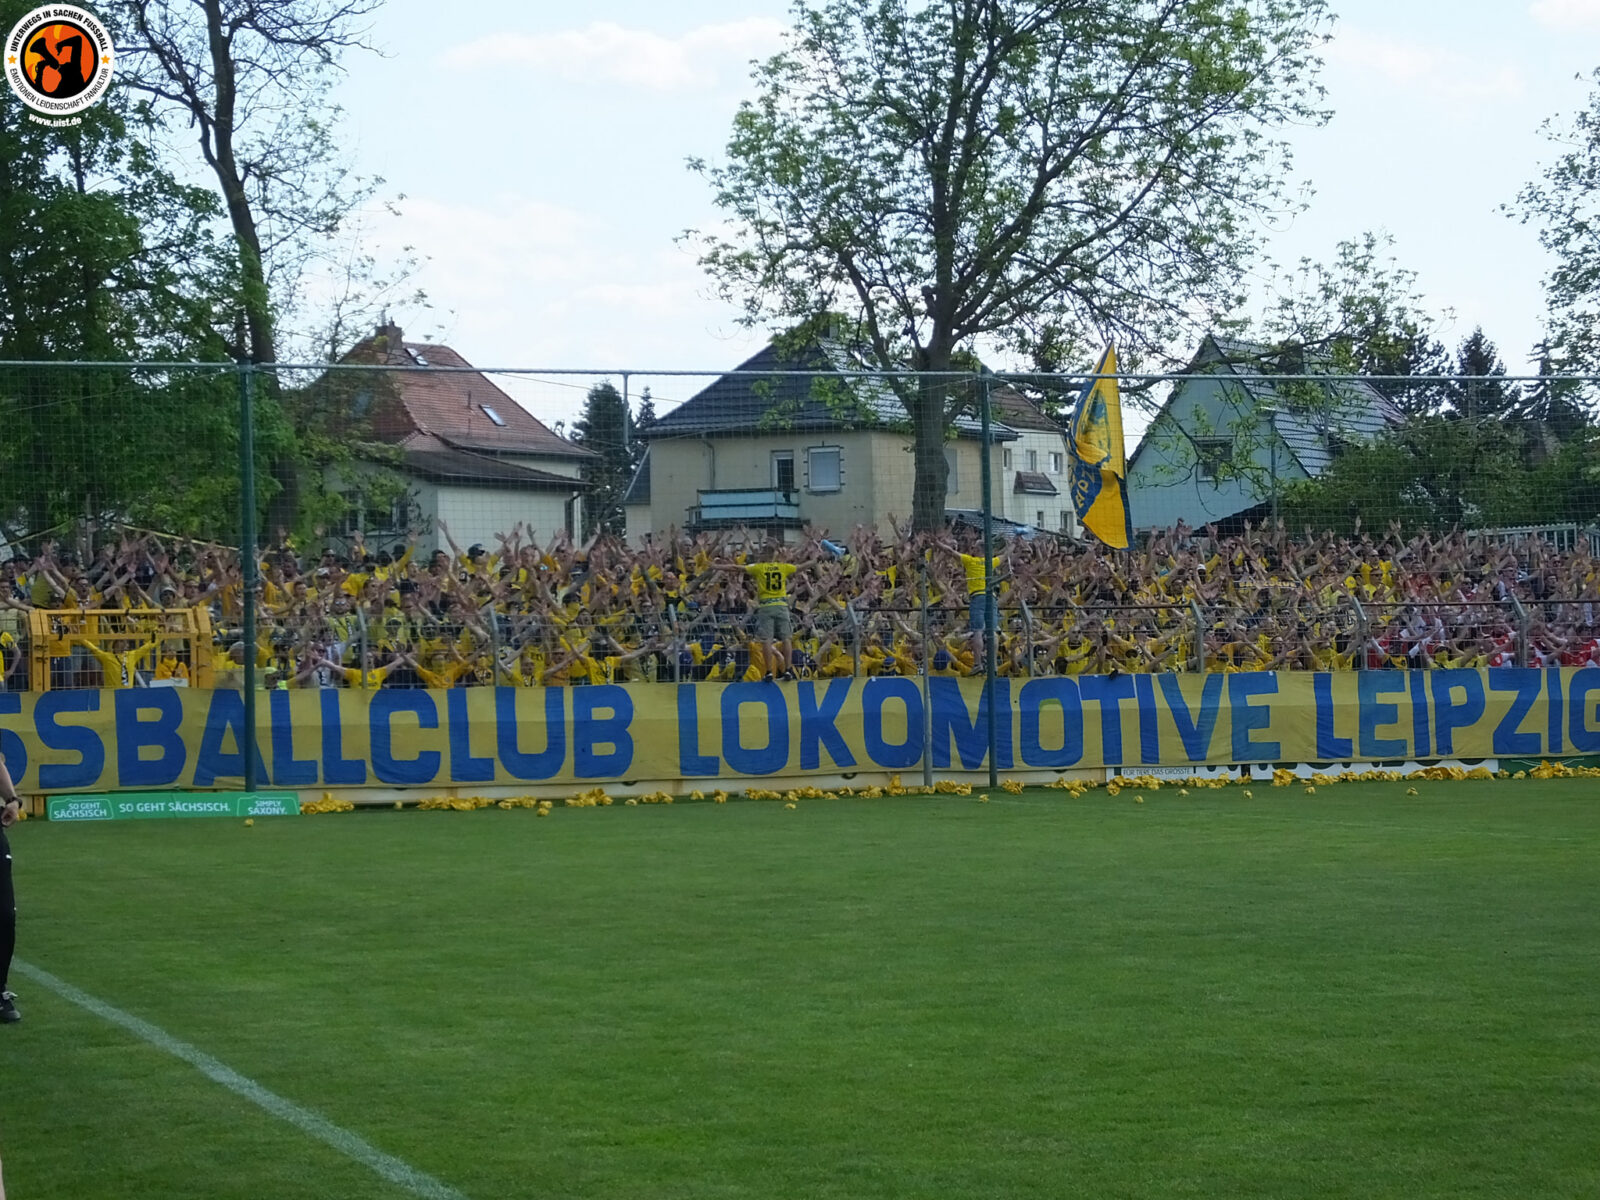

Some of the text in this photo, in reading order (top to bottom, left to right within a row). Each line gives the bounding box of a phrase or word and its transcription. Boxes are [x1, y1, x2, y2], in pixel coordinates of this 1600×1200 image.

[764, 572, 782, 590] 13
[677, 672, 1281, 777] LOKOMOTIVE
[118, 803, 134, 813] SO
[136, 802, 166, 812] GEHT
